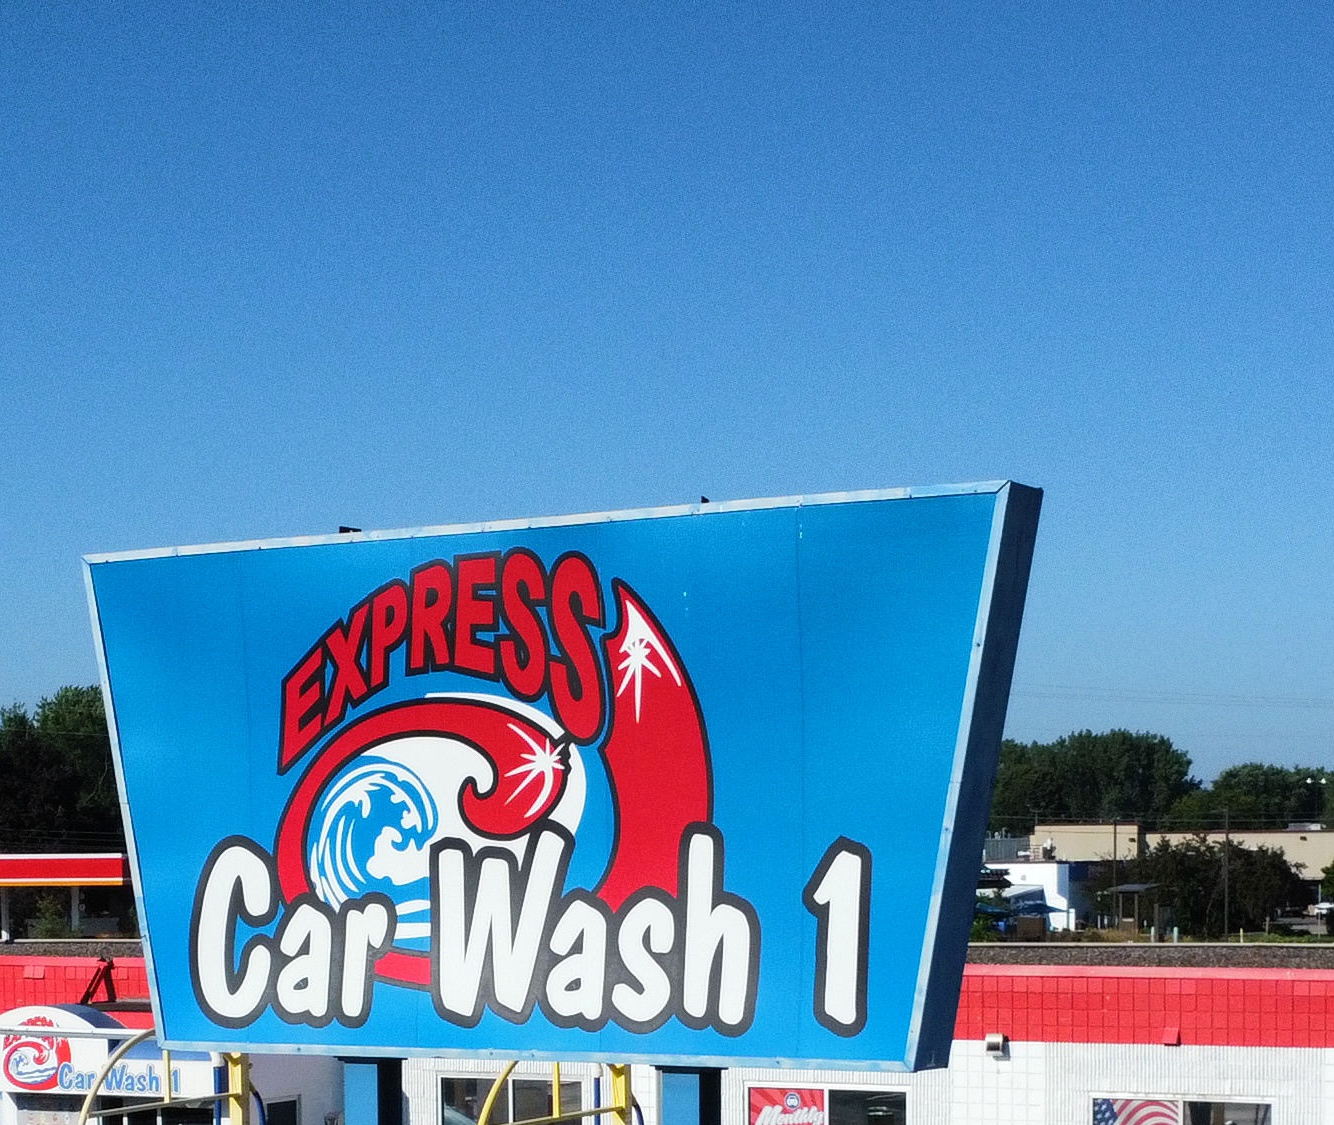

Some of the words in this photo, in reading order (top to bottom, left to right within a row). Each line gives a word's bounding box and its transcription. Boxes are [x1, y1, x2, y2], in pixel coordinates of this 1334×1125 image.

[277, 547, 605, 775] EXPRESS
[189, 834, 395, 1028] Car
[430, 820, 760, 1037] Wash
[801, 835, 871, 1037] 1
[58, 1062, 95, 1091] Car
[105, 1063, 162, 1094] Wash
[170, 1067, 181, 1094] 1
